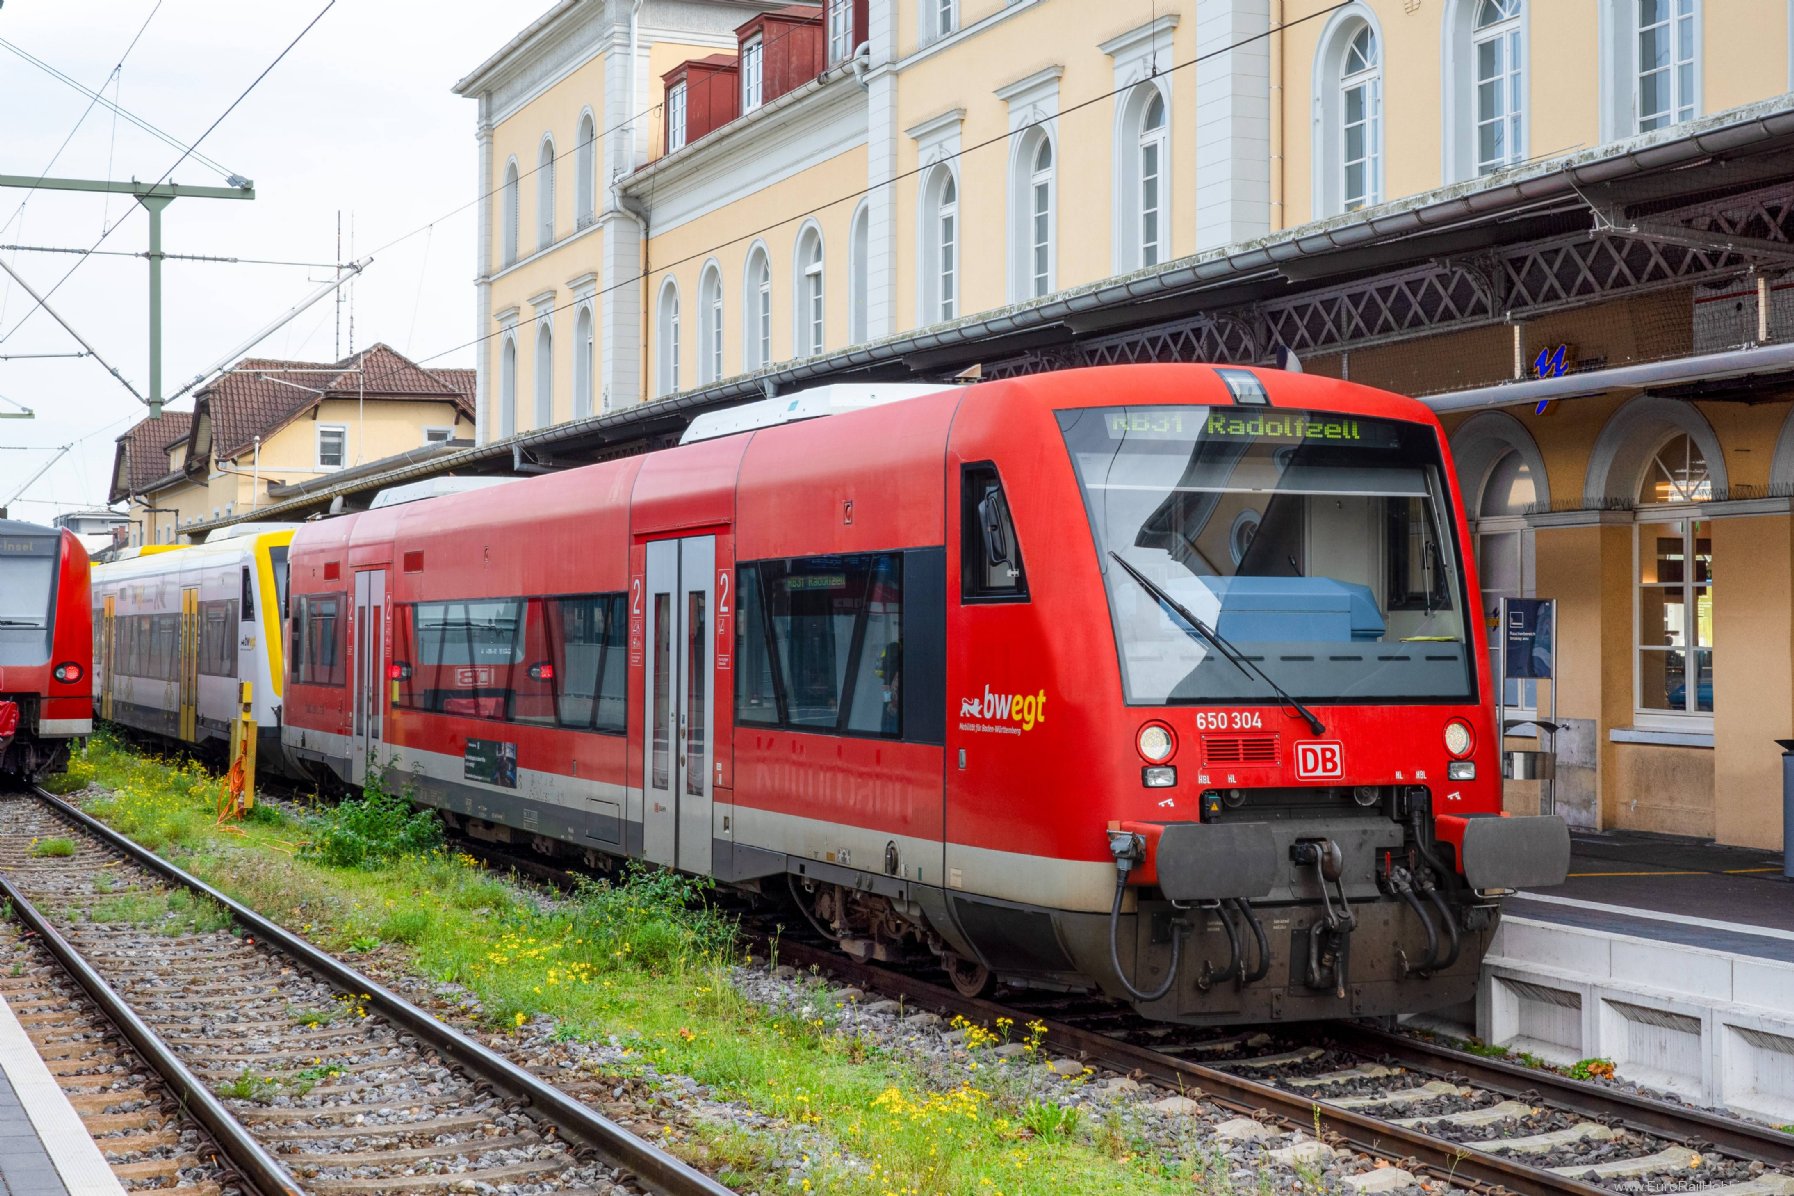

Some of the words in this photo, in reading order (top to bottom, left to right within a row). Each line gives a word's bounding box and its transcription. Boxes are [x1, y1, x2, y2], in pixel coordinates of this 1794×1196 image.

[1112, 415, 1182, 433] RB31
[1207, 415, 1360, 440] Radolfzell
[633, 579, 641, 614] 2
[720, 573, 729, 612] 2
[348, 596, 353, 620] 2
[385, 595, 391, 620] 2
[983, 684, 1047, 731] bwegt
[982, 724, 1021, 736] Baden-Württemberg
[1197, 712, 1228, 729] 650
[1231, 712, 1262, 729] 304
[1301, 747, 1339, 773] DB
[1198, 774, 1211, 785] HBL
[1227, 774, 1237, 784] HL
[1395, 770, 1403, 780] HL
[1415, 770, 1427, 780] HBL
